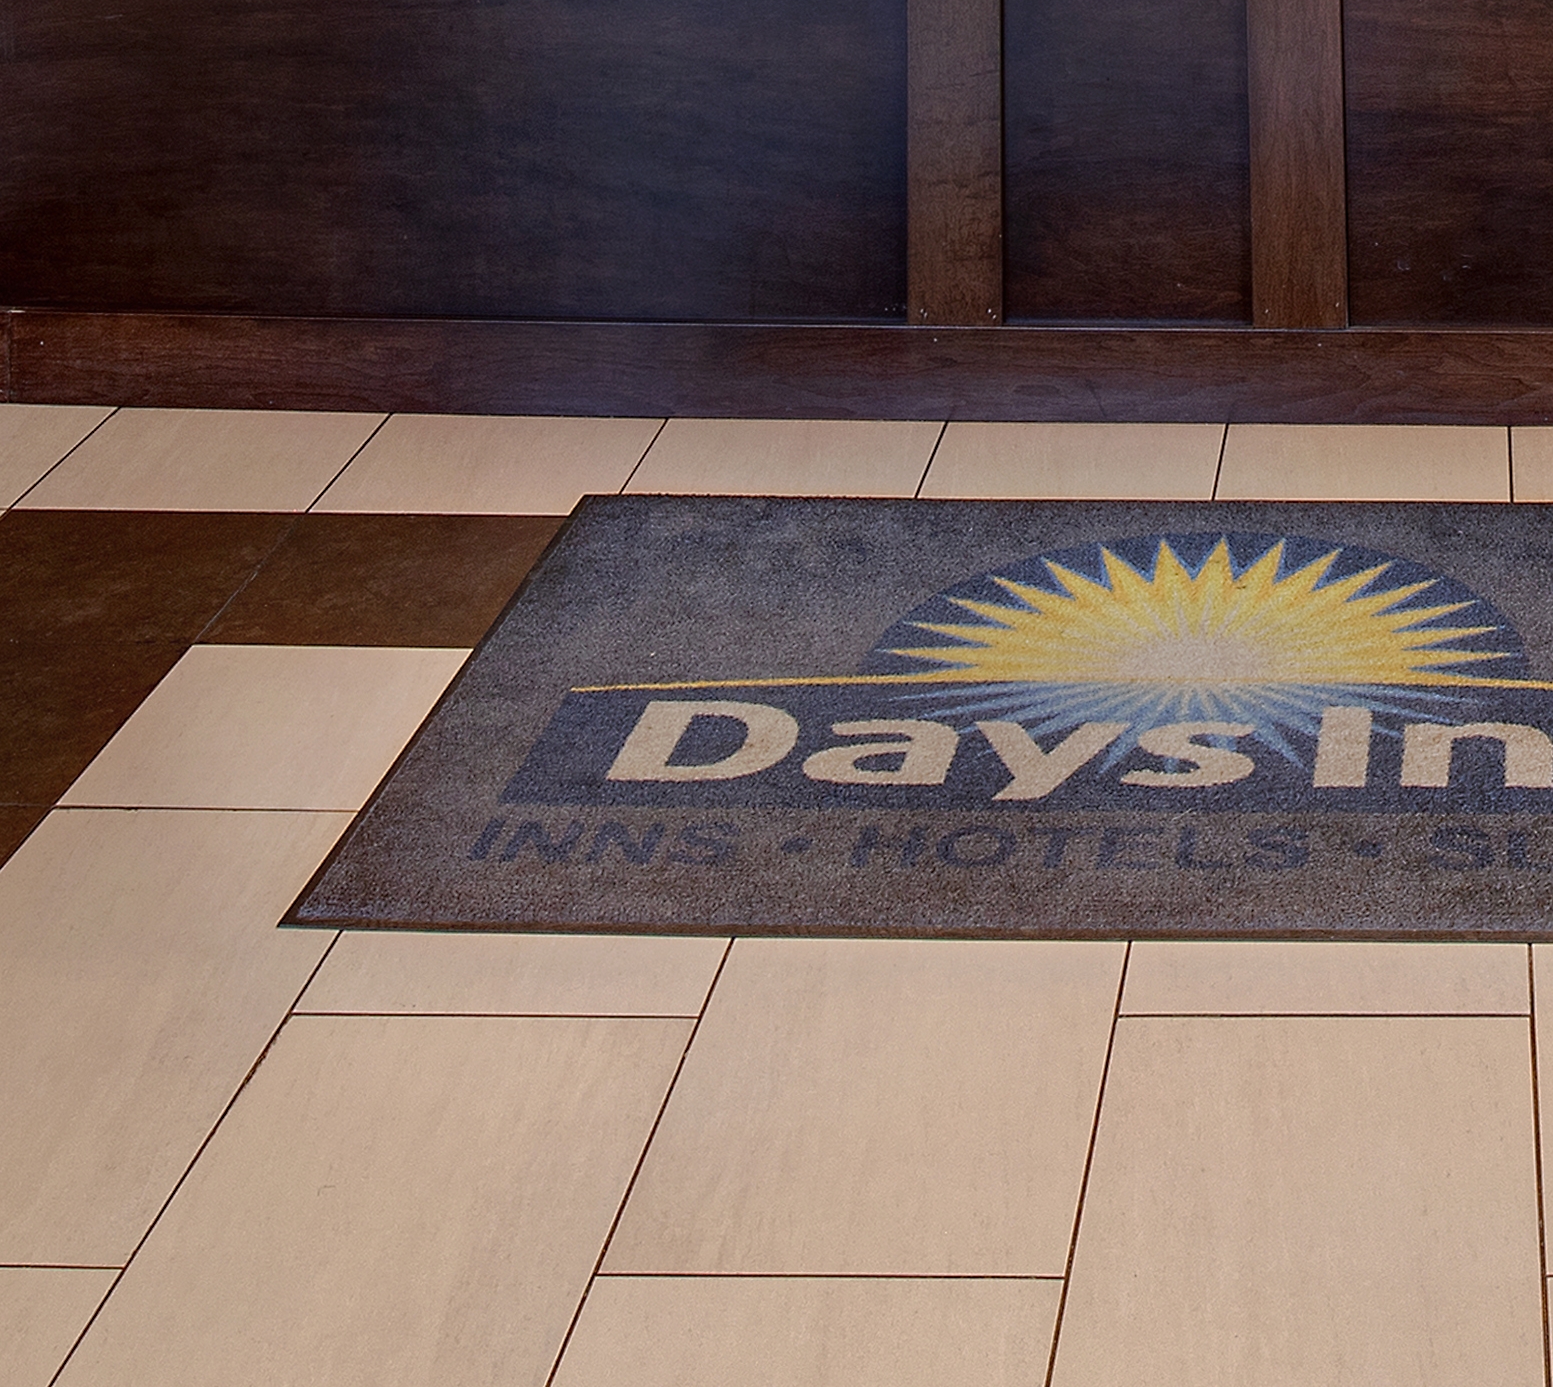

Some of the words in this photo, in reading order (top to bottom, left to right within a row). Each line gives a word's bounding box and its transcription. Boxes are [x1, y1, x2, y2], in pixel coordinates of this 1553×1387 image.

[607, 700, 1255, 801] Days
[464, 818, 744, 868] INNS
[848, 823, 1309, 872] HOTELS
